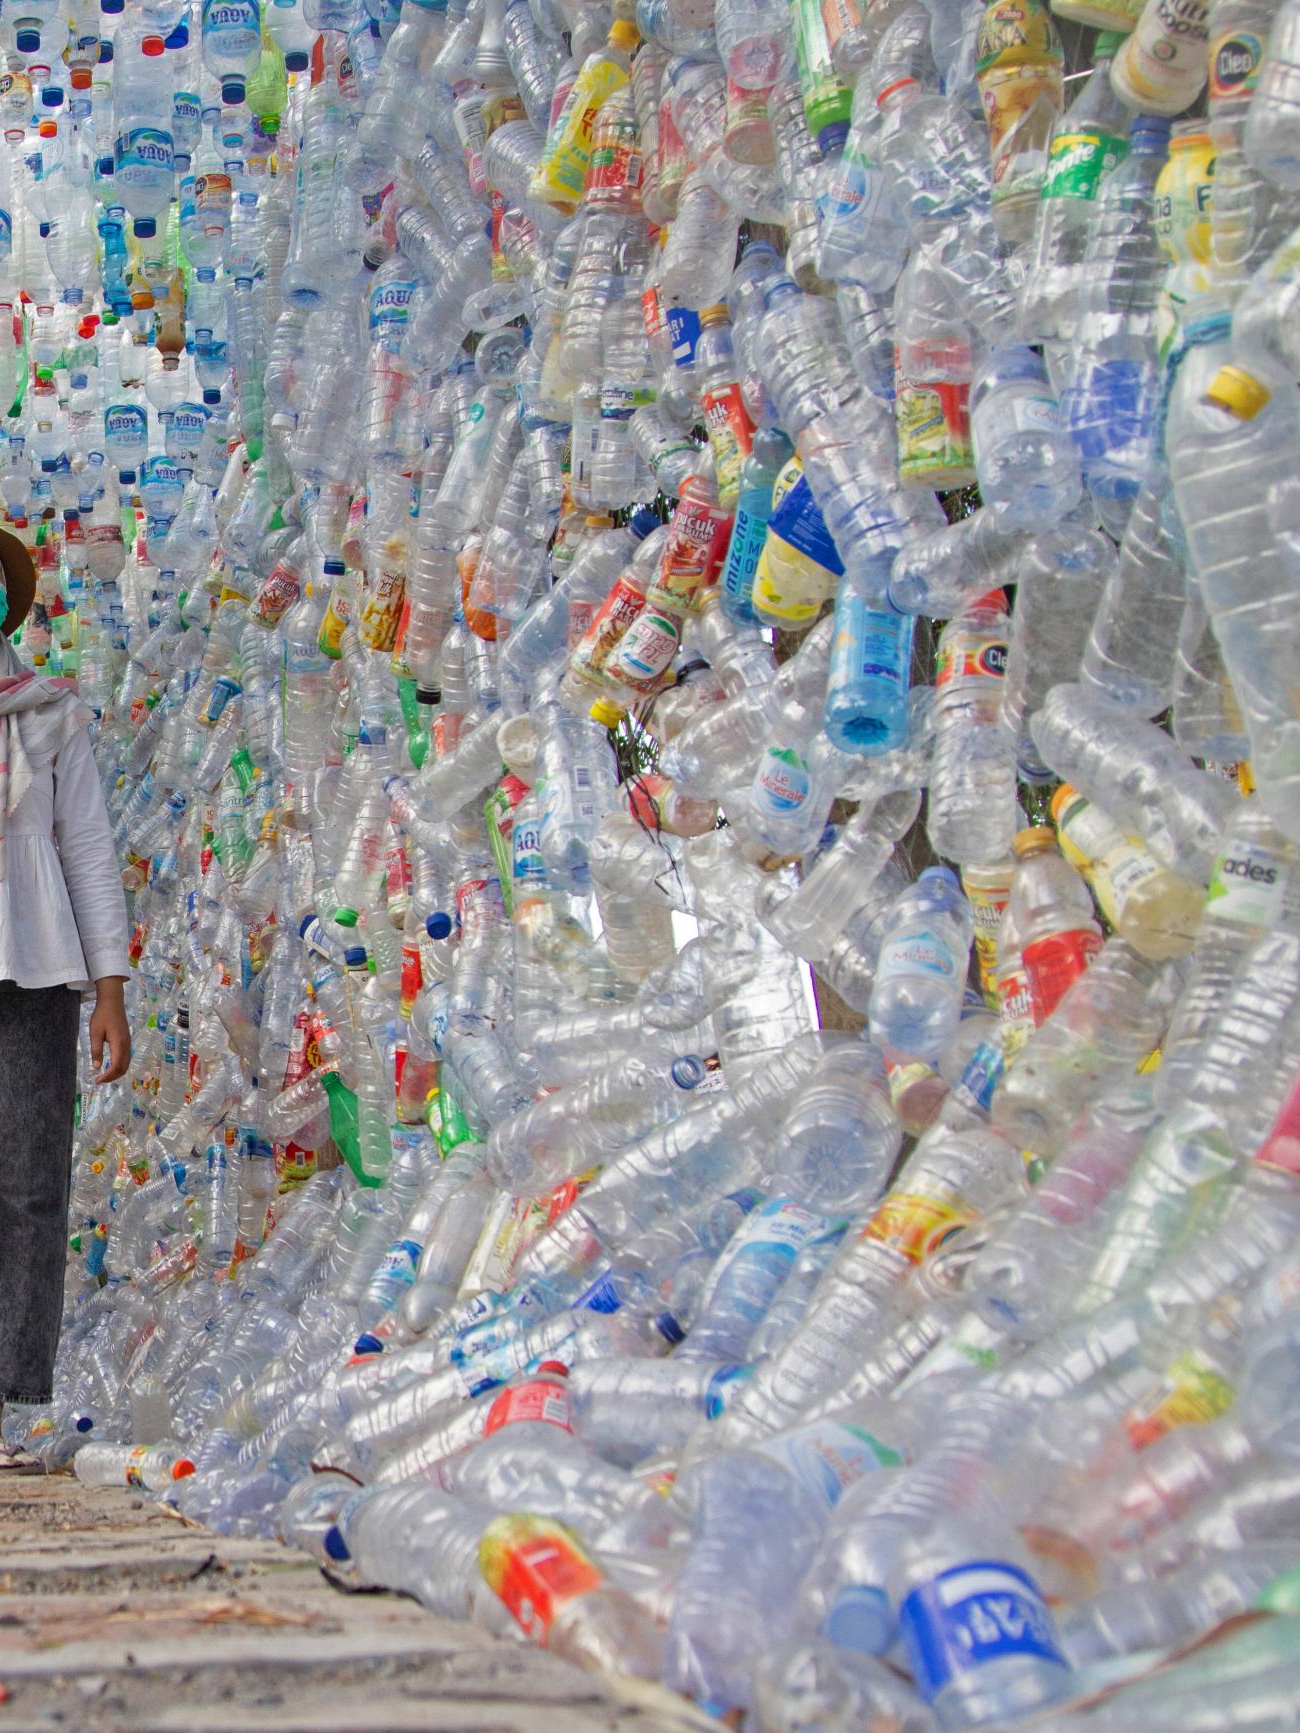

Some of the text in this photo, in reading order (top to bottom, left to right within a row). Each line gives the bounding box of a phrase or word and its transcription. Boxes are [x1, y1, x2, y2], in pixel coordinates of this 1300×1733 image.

[210, 8, 250, 25] AQUA
[1220, 52, 1254, 74] Cleo
[136, 144, 174, 163] AQUA
[109, 415, 138, 430] AQUA
[174, 414, 204, 428] AQUA
[675, 512, 718, 534] pucuk
[725, 510, 749, 592] mizone
[760, 770, 806, 803] Minerale
[1223, 859, 1278, 885] ades
